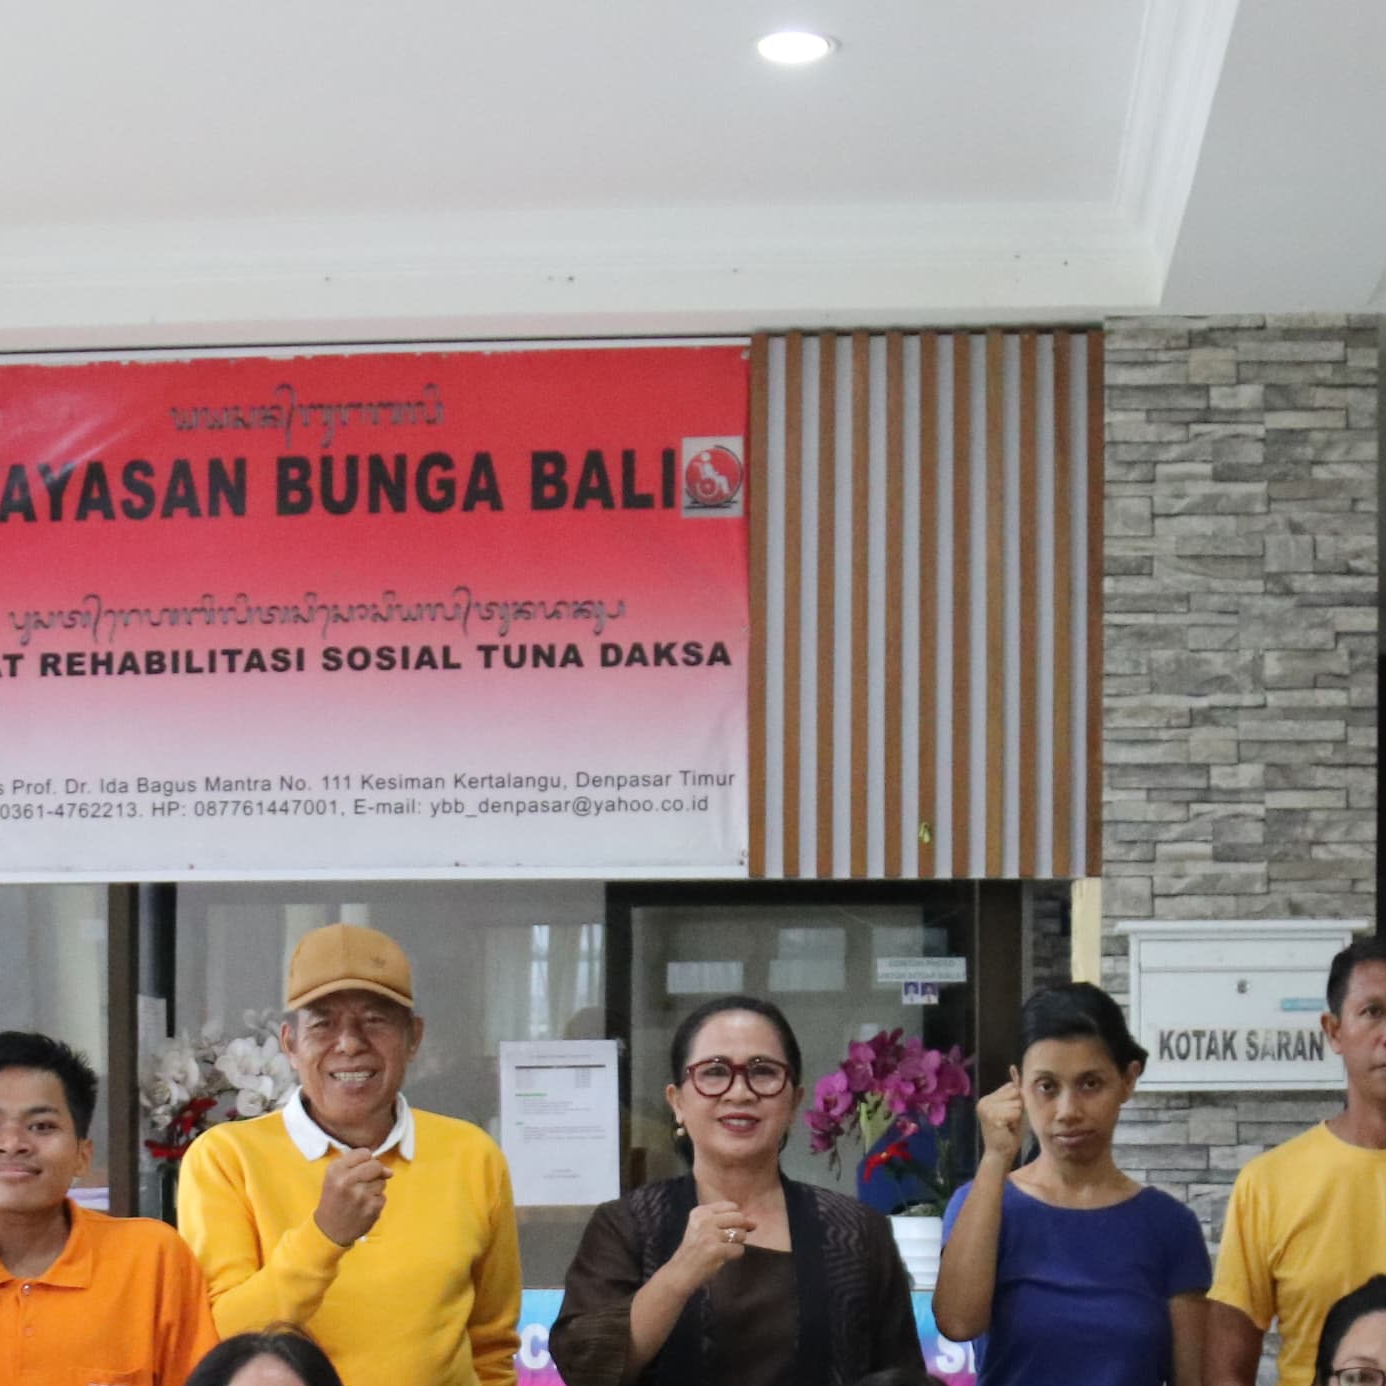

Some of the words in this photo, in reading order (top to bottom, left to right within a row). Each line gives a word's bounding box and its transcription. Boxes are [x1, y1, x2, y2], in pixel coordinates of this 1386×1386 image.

[277, 451, 503, 515] BUNGA
[531, 448, 675, 511] BALI
[40, 648, 304, 676] REHABILITASI
[322, 645, 461, 671] SOSIAL
[477, 643, 584, 669] TUNA
[601, 642, 731, 667] DAKSA
[13, 779, 56, 795] Prof.
[65, 778, 92, 794] Dr.
[101, 779, 128, 793] Ida
[137, 777, 197, 797] Bagus
[205, 777, 271, 792] Mantra
[280, 776, 311, 791] No.
[323, 775, 350, 790] 111
[361, 775, 445, 790] Kesiman
[454, 773, 566, 792] Kertalangu,
[576, 772, 671, 791] Denpasar
[679, 770, 735, 786] Timur
[152, 801, 186, 817] HP:
[354, 799, 421, 814] E-mail:
[431, 795, 708, 817] ybb_denpasar@yahoo.co.id
[1159, 1030, 1237, 1061] KOTAK
[1246, 1030, 1324, 1061] SARAN
